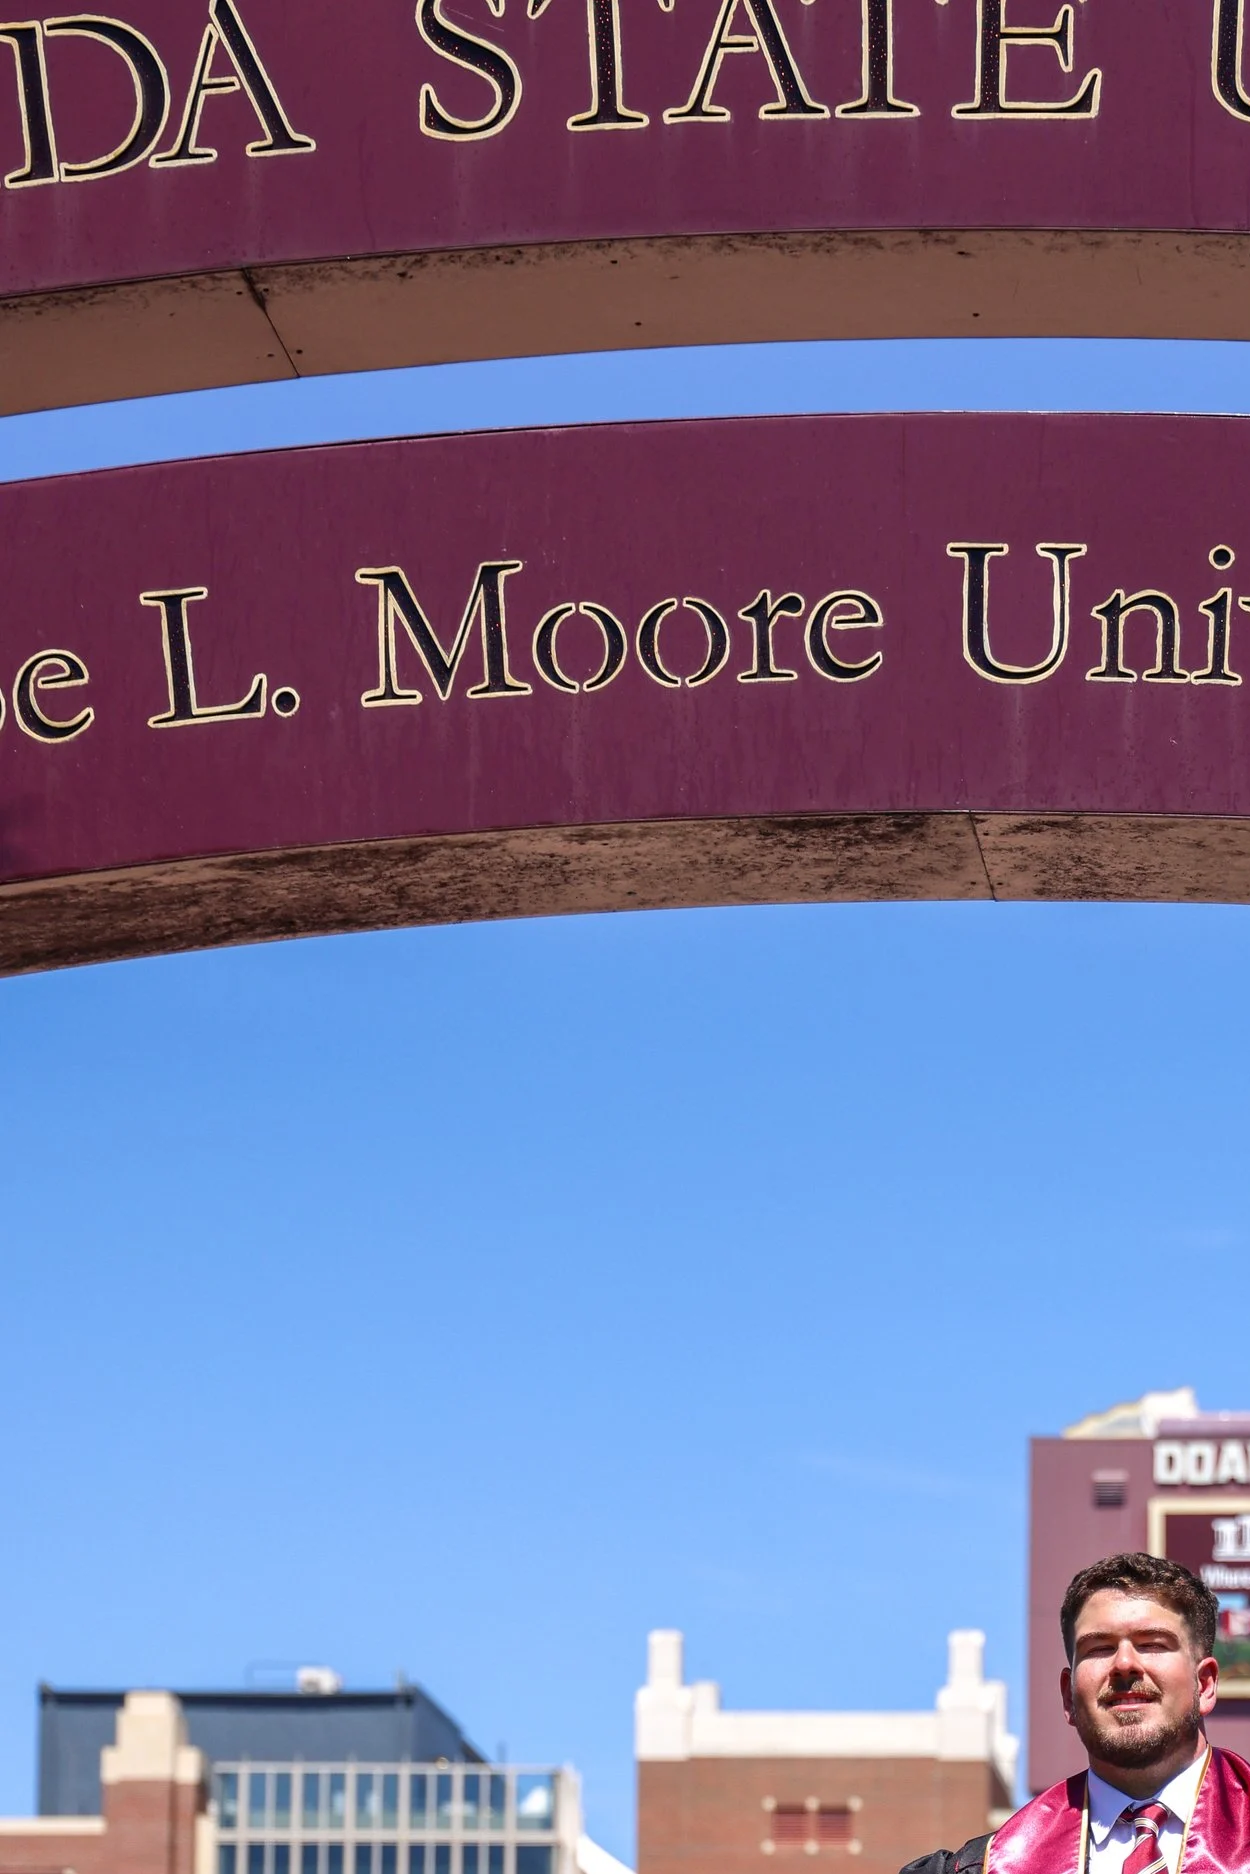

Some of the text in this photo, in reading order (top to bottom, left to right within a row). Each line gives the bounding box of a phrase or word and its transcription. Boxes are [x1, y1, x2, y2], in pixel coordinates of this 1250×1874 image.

[415, 0, 1101, 141] STATE
[140, 586, 301, 729] L.
[355, 560, 884, 705] Moore
